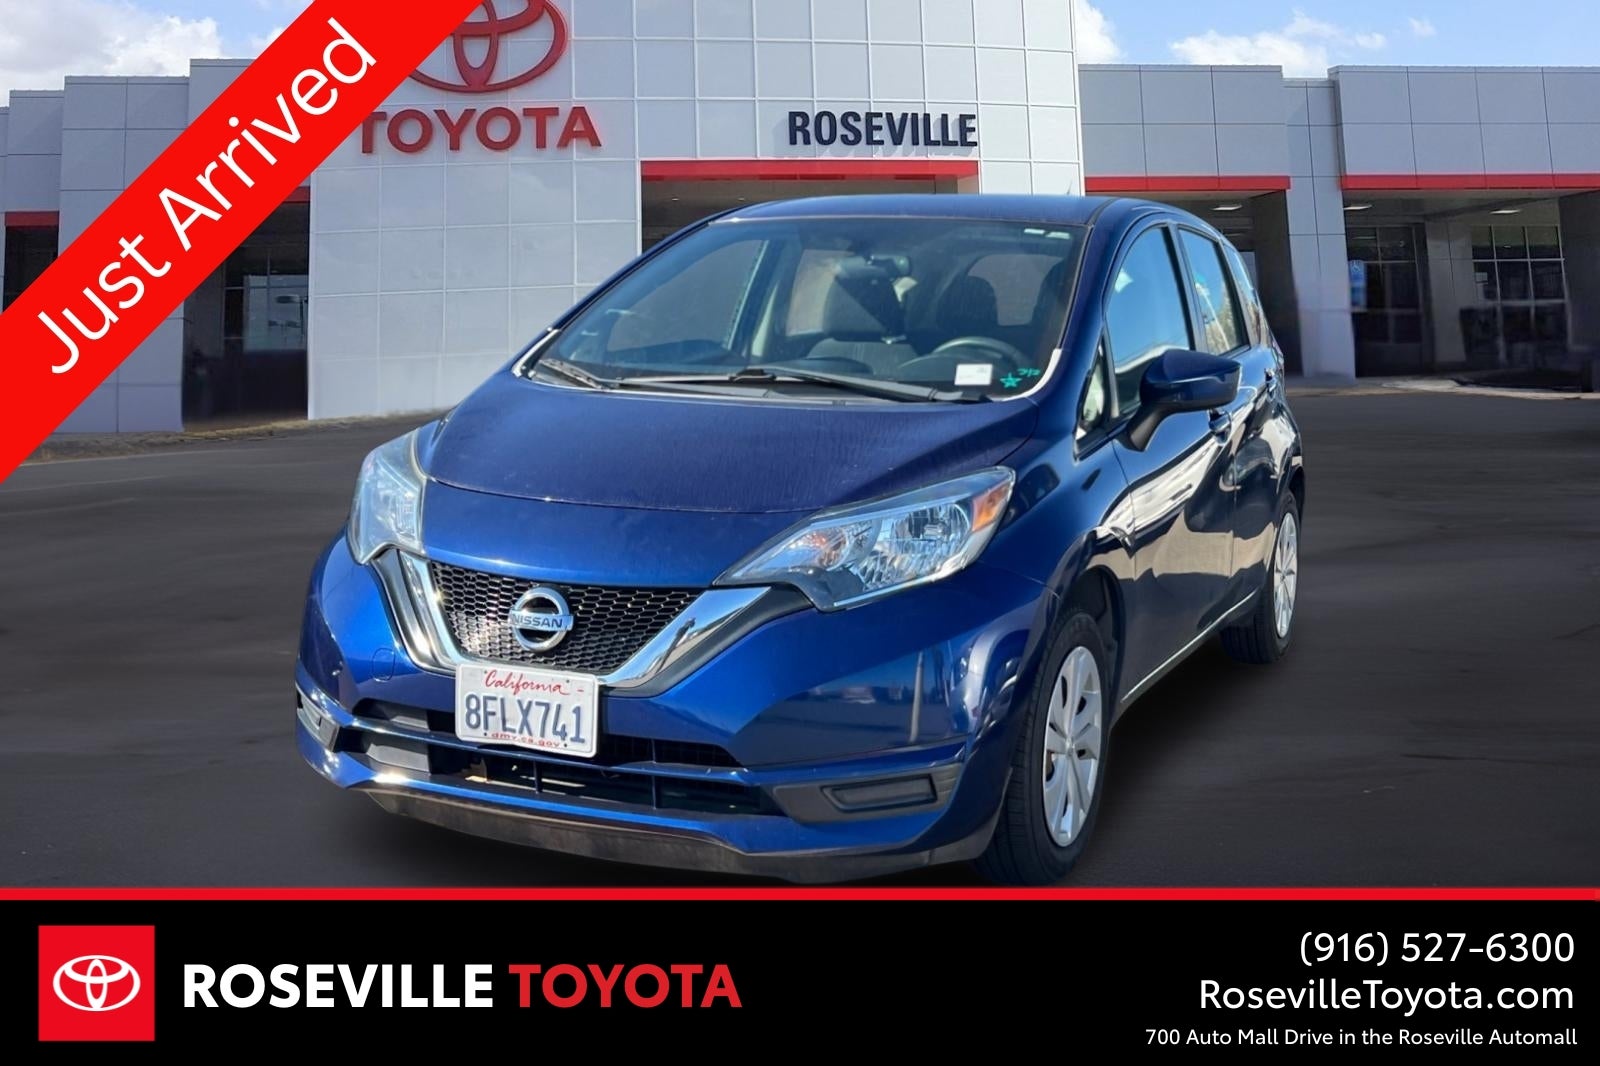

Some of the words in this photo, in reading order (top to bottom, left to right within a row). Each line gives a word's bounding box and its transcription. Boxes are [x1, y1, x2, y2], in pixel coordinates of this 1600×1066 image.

[361, 106, 602, 154] TOYOTA
[788, 110, 978, 147] ROSEVILLE
[511, 613, 563, 629] NISSAN
[485, 669, 571, 696] California
[465, 693, 586, 744] 8FLX741
[491, 732, 560, 748] dmv.ca.gov
